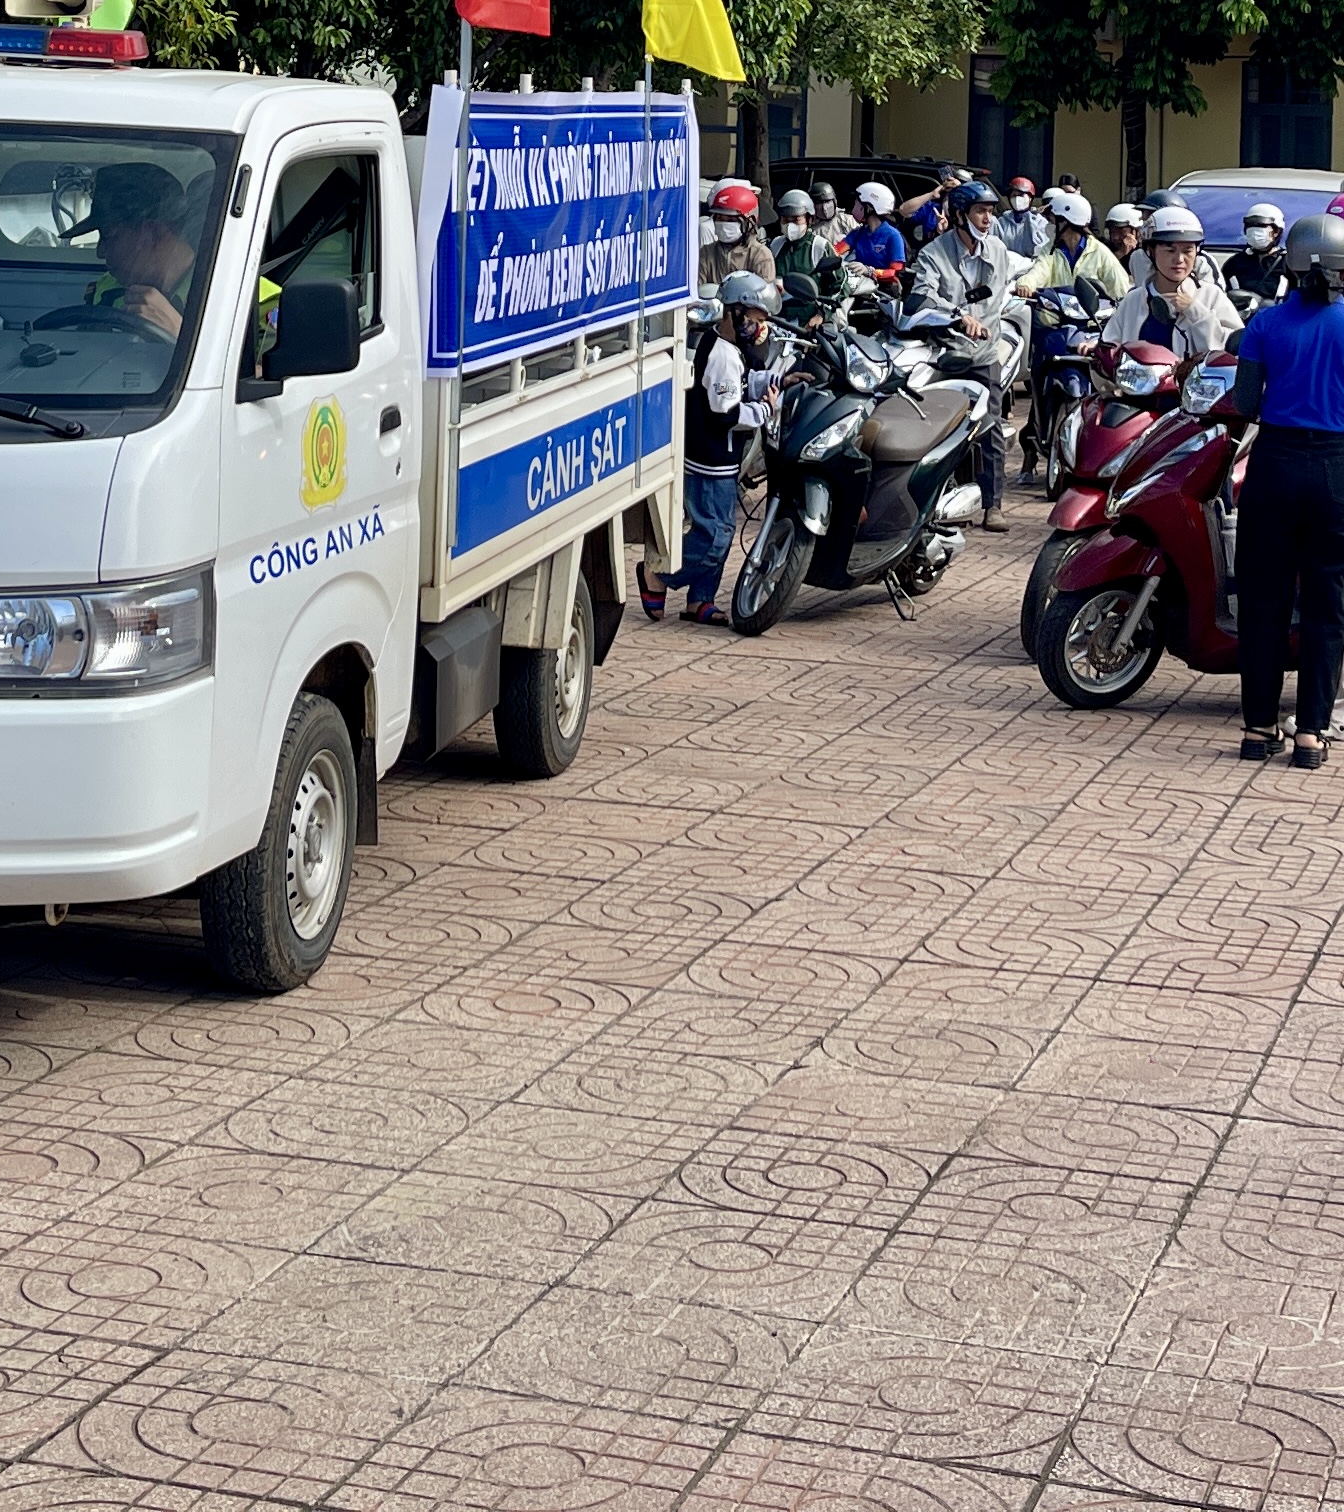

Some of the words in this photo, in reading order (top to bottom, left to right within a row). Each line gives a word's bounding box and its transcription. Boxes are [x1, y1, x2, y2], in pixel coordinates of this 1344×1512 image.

[490, 125, 529, 210] MUỖI
[528, 135, 551, 207] VÀ
[548, 131, 592, 204] PHÒNG
[594, 131, 630, 198] TRÁNH
[630, 129, 656, 192] MUI
[657, 128, 685, 190] CHÍCH
[474, 232, 504, 323] ĐỂ
[499, 239, 551, 318] PHÒNG
[551, 234, 584, 317] BỆNH
[586, 219, 611, 297] SỐT
[607, 214, 634, 291] XUẤT
[526, 436, 585, 511] CẢNH
[590, 409, 627, 477] SÁT
[249, 537, 319, 584] CÔNG
[325, 523, 353, 559] AN
[358, 504, 385, 546] XÃ
